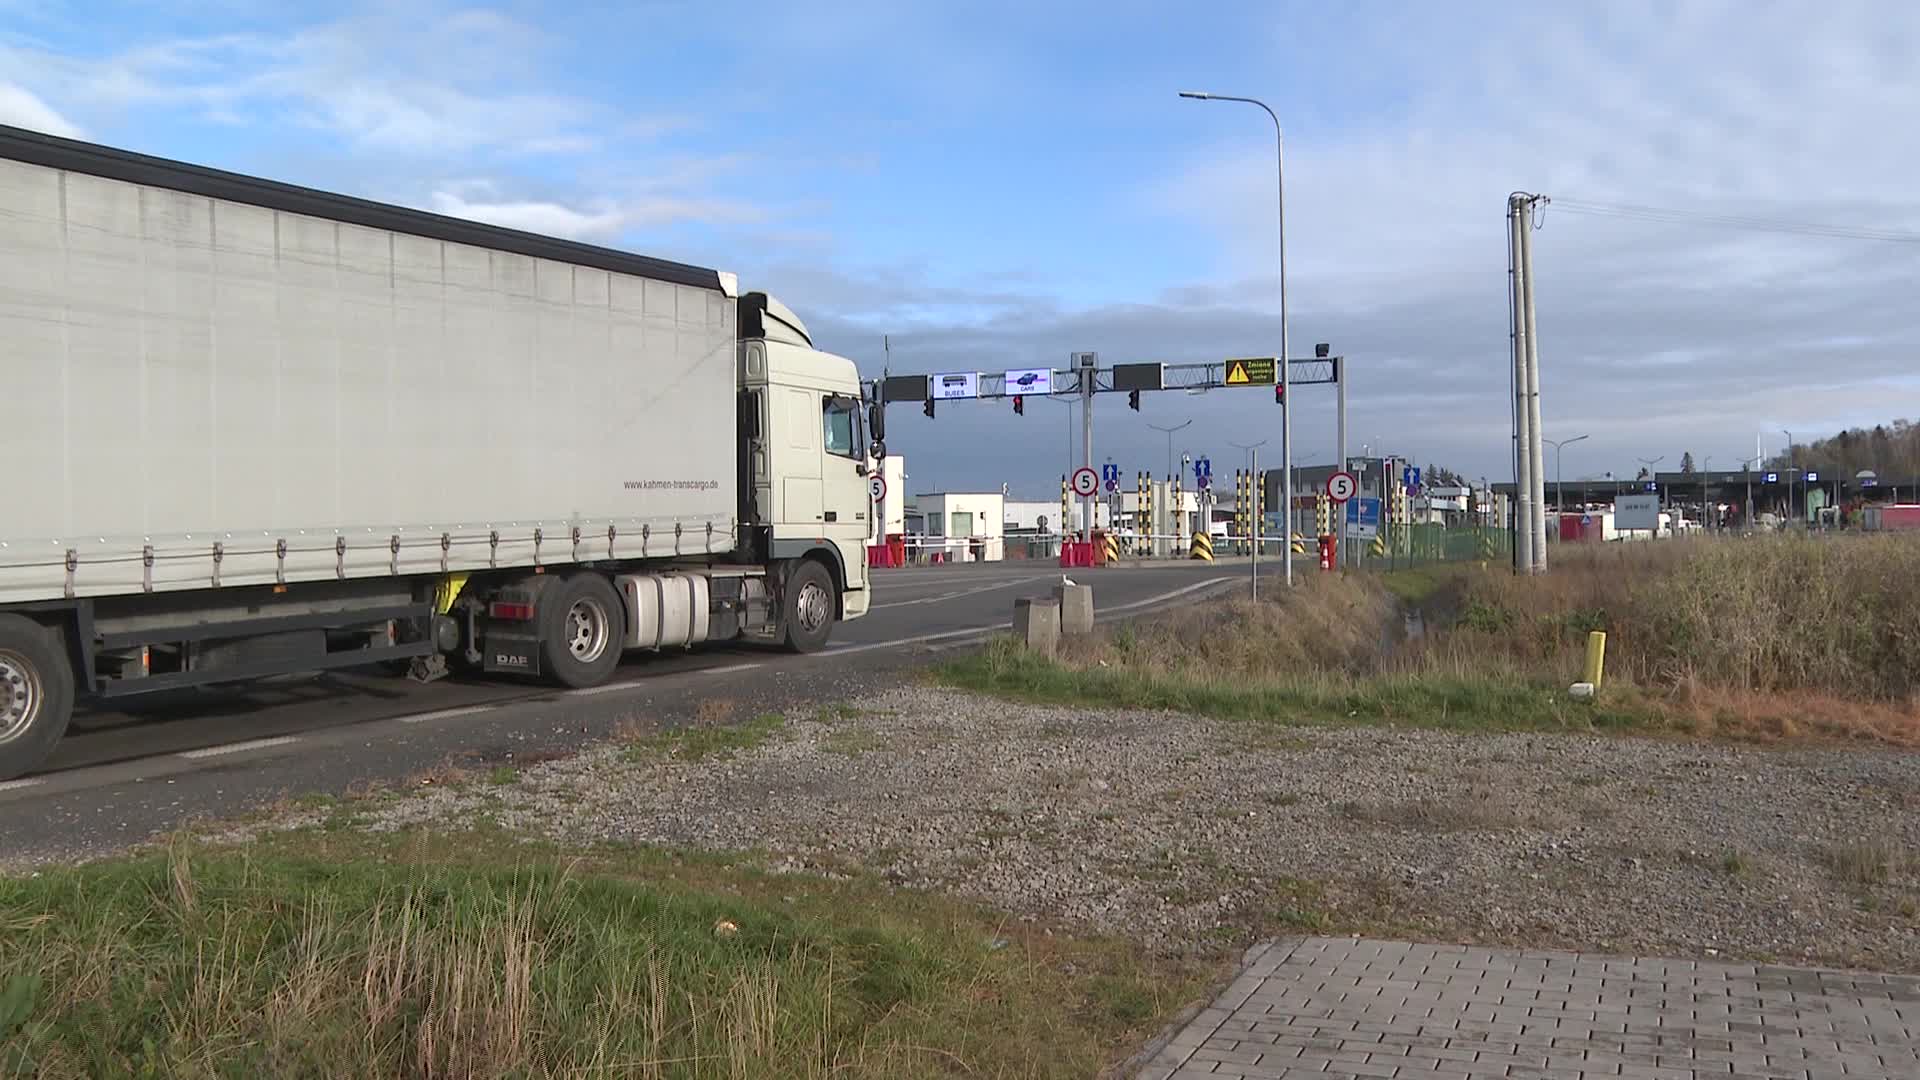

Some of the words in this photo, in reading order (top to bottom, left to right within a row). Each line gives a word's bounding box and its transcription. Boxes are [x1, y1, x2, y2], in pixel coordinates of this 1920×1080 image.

[944, 389, 965, 397] BUSES
[623, 479, 718, 491] www.kahmen-transcargo.de
[1082, 475, 1090, 489] 5
[1337, 480, 1346, 494] 5
[873, 482, 880, 496] 5
[496, 654, 528, 665] DAF
